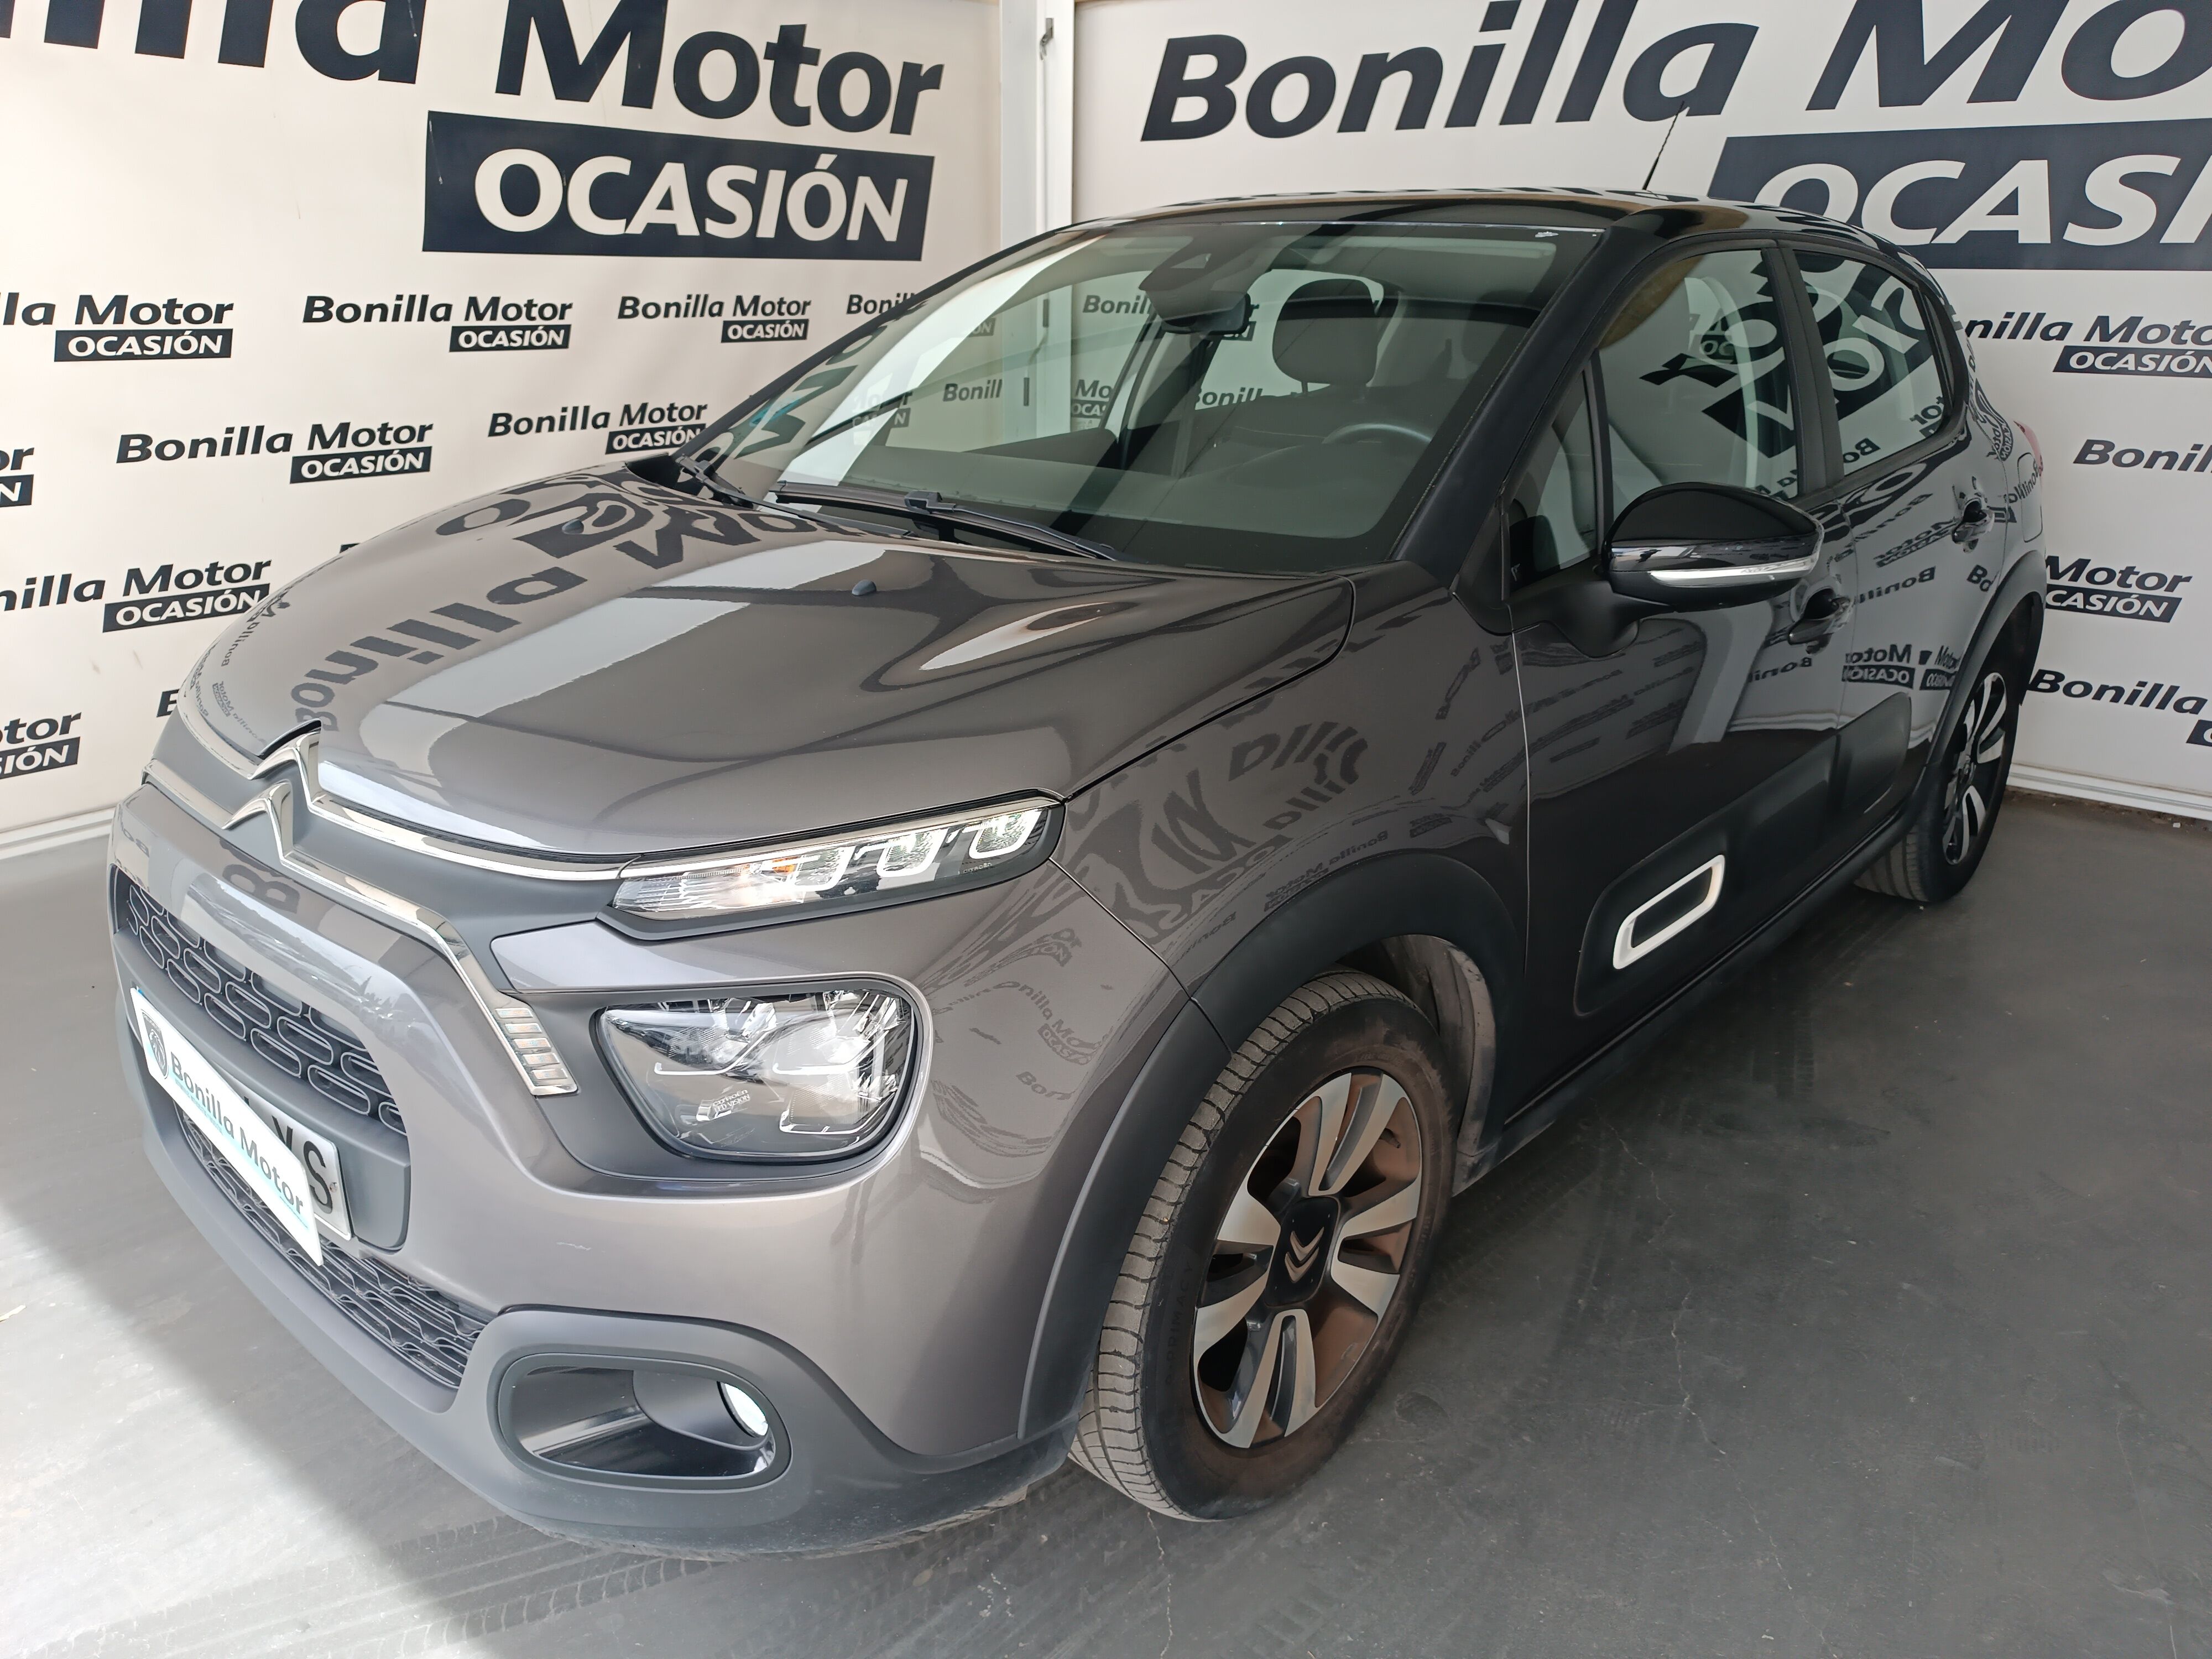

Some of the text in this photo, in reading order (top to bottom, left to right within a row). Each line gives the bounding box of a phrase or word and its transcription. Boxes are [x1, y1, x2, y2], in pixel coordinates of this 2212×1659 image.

[495, 0, 943, 135] Motor
[1140, 0, 1759, 142] Bonilla
[474, 148, 908, 242] OCASIÓN
[75, 295, 233, 326] Motor
[303, 294, 573, 323] Bonilla Motor
[617, 294, 811, 319] Bonilla Motor
[67, 331, 223, 357] OCASIÓN
[458, 325, 565, 349] OCASIÓN
[727, 319, 805, 339] OCASIÓN
[2083, 315, 2212, 346] Moto
[2069, 351, 2212, 374] OCASIÓN
[487, 402, 708, 437] Bonilla Motor
[116, 421, 434, 463] Bonilla Motor
[612, 425, 701, 450] OCASIÓN
[300, 451, 425, 479] OCASIÓN
[122, 559, 272, 598] Motor
[2046, 555, 2193, 593] Motor
[116, 590, 260, 628] OCASIÓN
[2028, 668, 2209, 716] Bonilla
[0, 712, 82, 744] tor
[0, 744, 69, 775] IÓN
[170, 1051, 234, 1140] Bonilla
[240, 1126, 304, 1215] Motor
